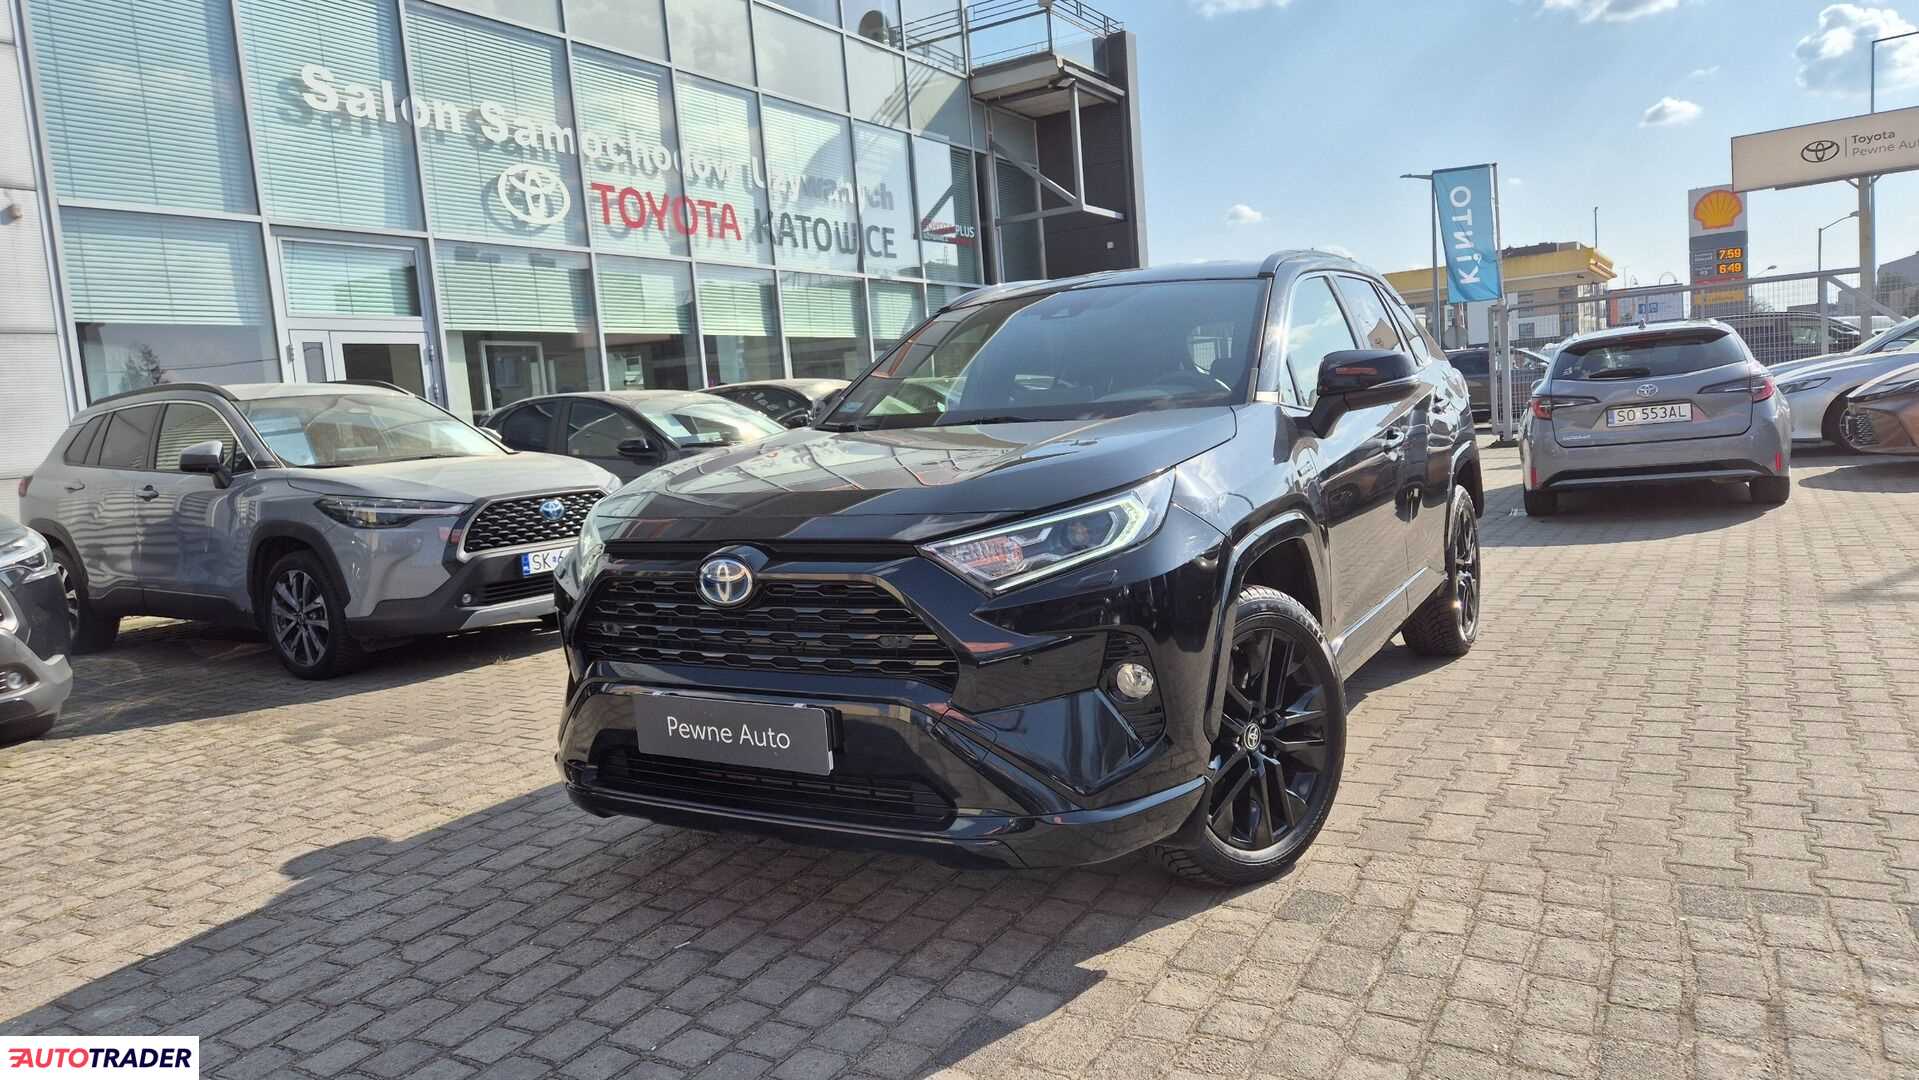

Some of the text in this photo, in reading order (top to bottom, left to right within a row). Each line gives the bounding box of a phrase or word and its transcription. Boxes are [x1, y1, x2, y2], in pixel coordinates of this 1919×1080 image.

[302, 64, 462, 133] Salon
[1851, 131, 1896, 145] Toyota
[1851, 144, 1896, 157] Pewne
[591, 182, 742, 241] TOYOTA
[1617, 405, 1687, 422] SO 553AL
[667, 716, 791, 749] Pewne Auto
